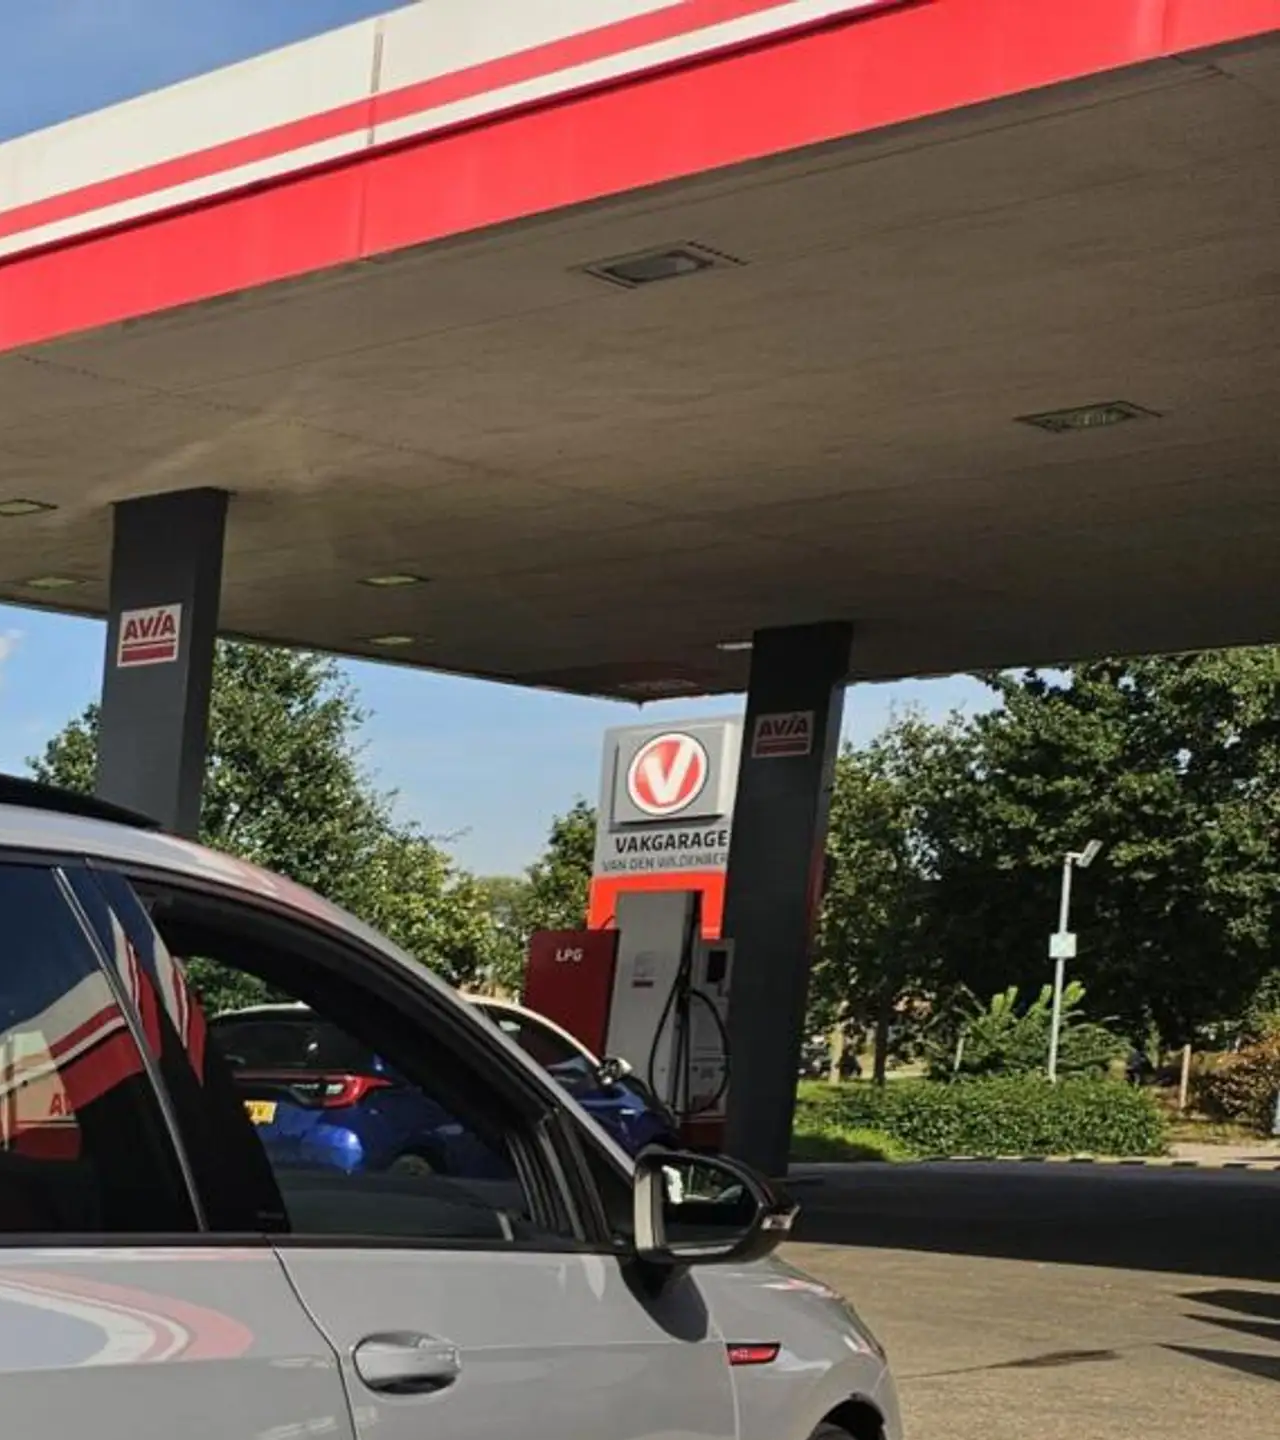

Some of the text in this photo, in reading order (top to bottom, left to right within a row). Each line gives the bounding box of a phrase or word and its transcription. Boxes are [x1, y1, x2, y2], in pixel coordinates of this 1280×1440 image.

[122, 610, 176, 641] AVIA
[757, 713, 808, 738] AVIA
[615, 830, 728, 854] VAKGARAGE
[555, 948, 582, 962] LPG
